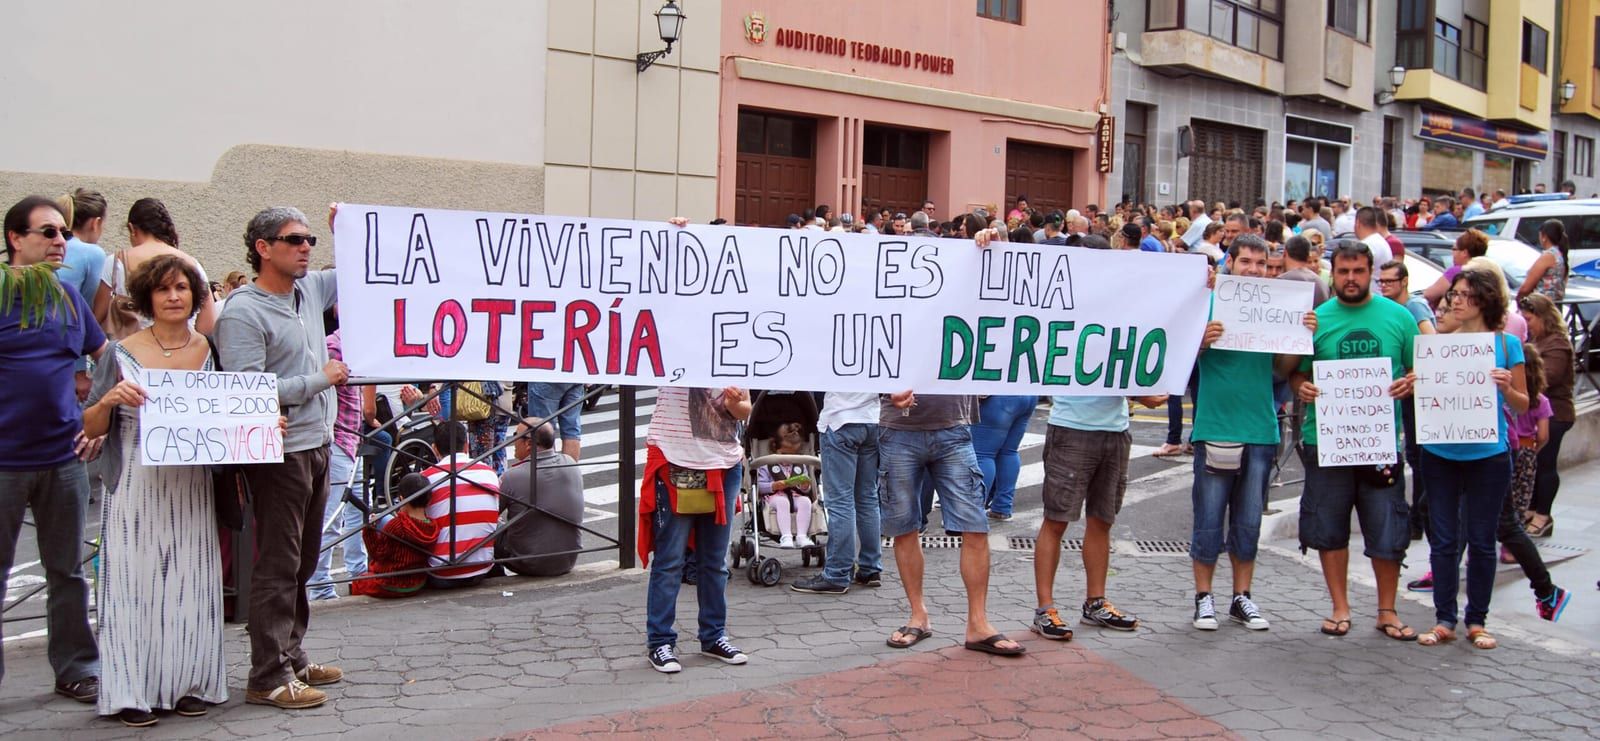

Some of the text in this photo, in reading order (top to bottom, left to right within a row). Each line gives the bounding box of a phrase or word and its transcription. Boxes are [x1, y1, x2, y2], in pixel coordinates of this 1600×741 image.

[776, 27, 955, 75] AUDITORIO TEOBALDO POWER
[365, 211, 440, 285] LA
[778, 235, 846, 297] NO
[875, 241, 944, 299] ES
[979, 248, 1074, 310] UNA
[1218, 279, 1271, 304] CASAS
[1265, 308, 1305, 325] GENT
[393, 297, 1168, 389] LOTERÍA, ES UN DERECHO
[1342, 339, 1378, 353] STOP
[1416, 343, 1496, 359] LA OROTAVA
[147, 371, 276, 390] LA OROTAVA:
[1317, 366, 1389, 381] LA OROTAVA
[1435, 371, 1449, 384] DE
[1456, 371, 1486, 386] 500
[198, 398, 220, 414] DE
[229, 396, 279, 415] 2000
[1320, 402, 1392, 417] VIVIENDAS
[1418, 395, 1493, 411] FAMILIAS
[1336, 424, 1372, 434] MANOS
[1375, 423, 1390, 433] DE
[145, 425, 227, 463] CASAS
[1336, 435, 1382, 450] BANCOS
[1330, 451, 1396, 464] CONSTRUCTORAS
